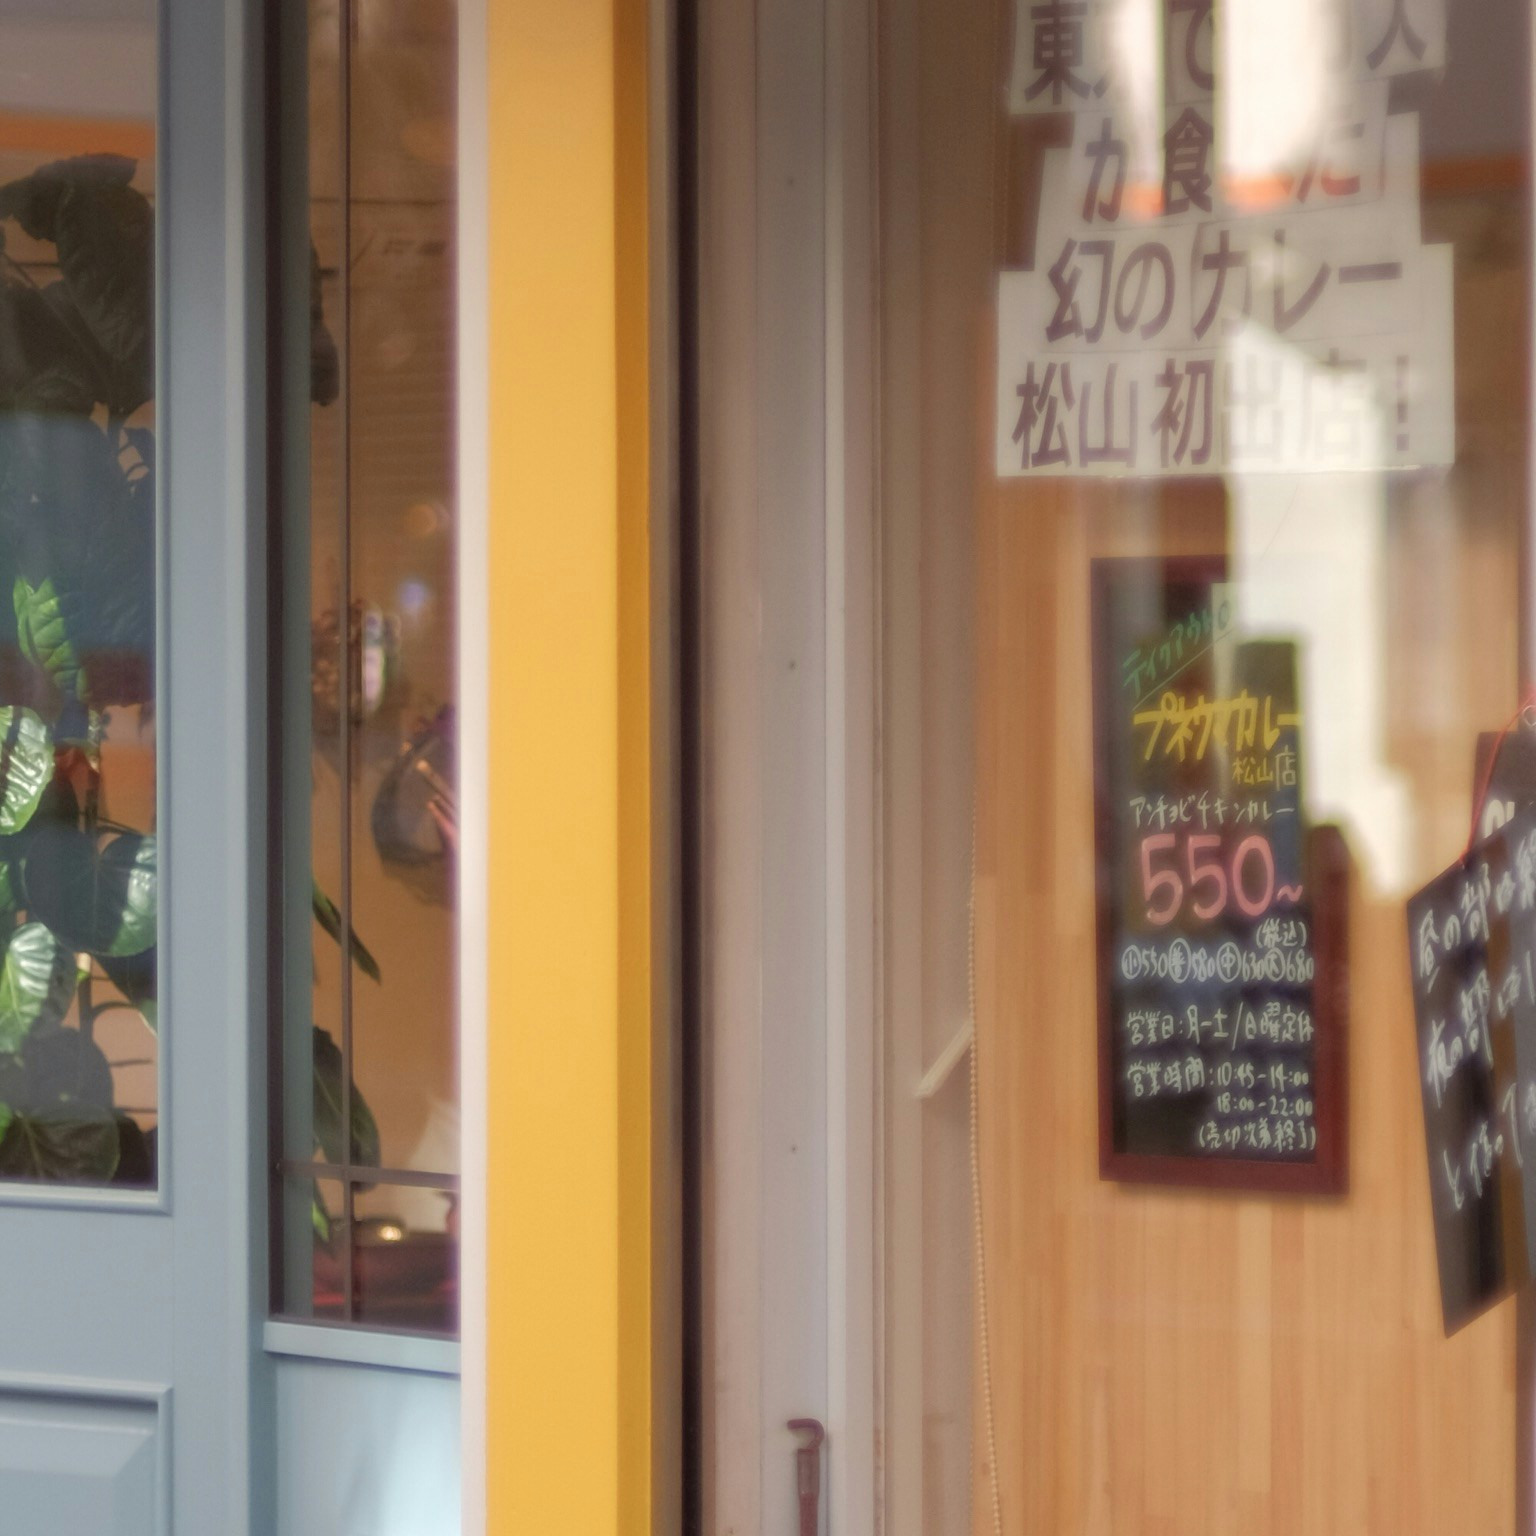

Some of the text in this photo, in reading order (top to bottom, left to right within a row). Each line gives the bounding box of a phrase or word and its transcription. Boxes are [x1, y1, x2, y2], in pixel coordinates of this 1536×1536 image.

[1045, 228, 1404, 345] 幻のカレー
[1231, 744, 1297, 792] 松山店
